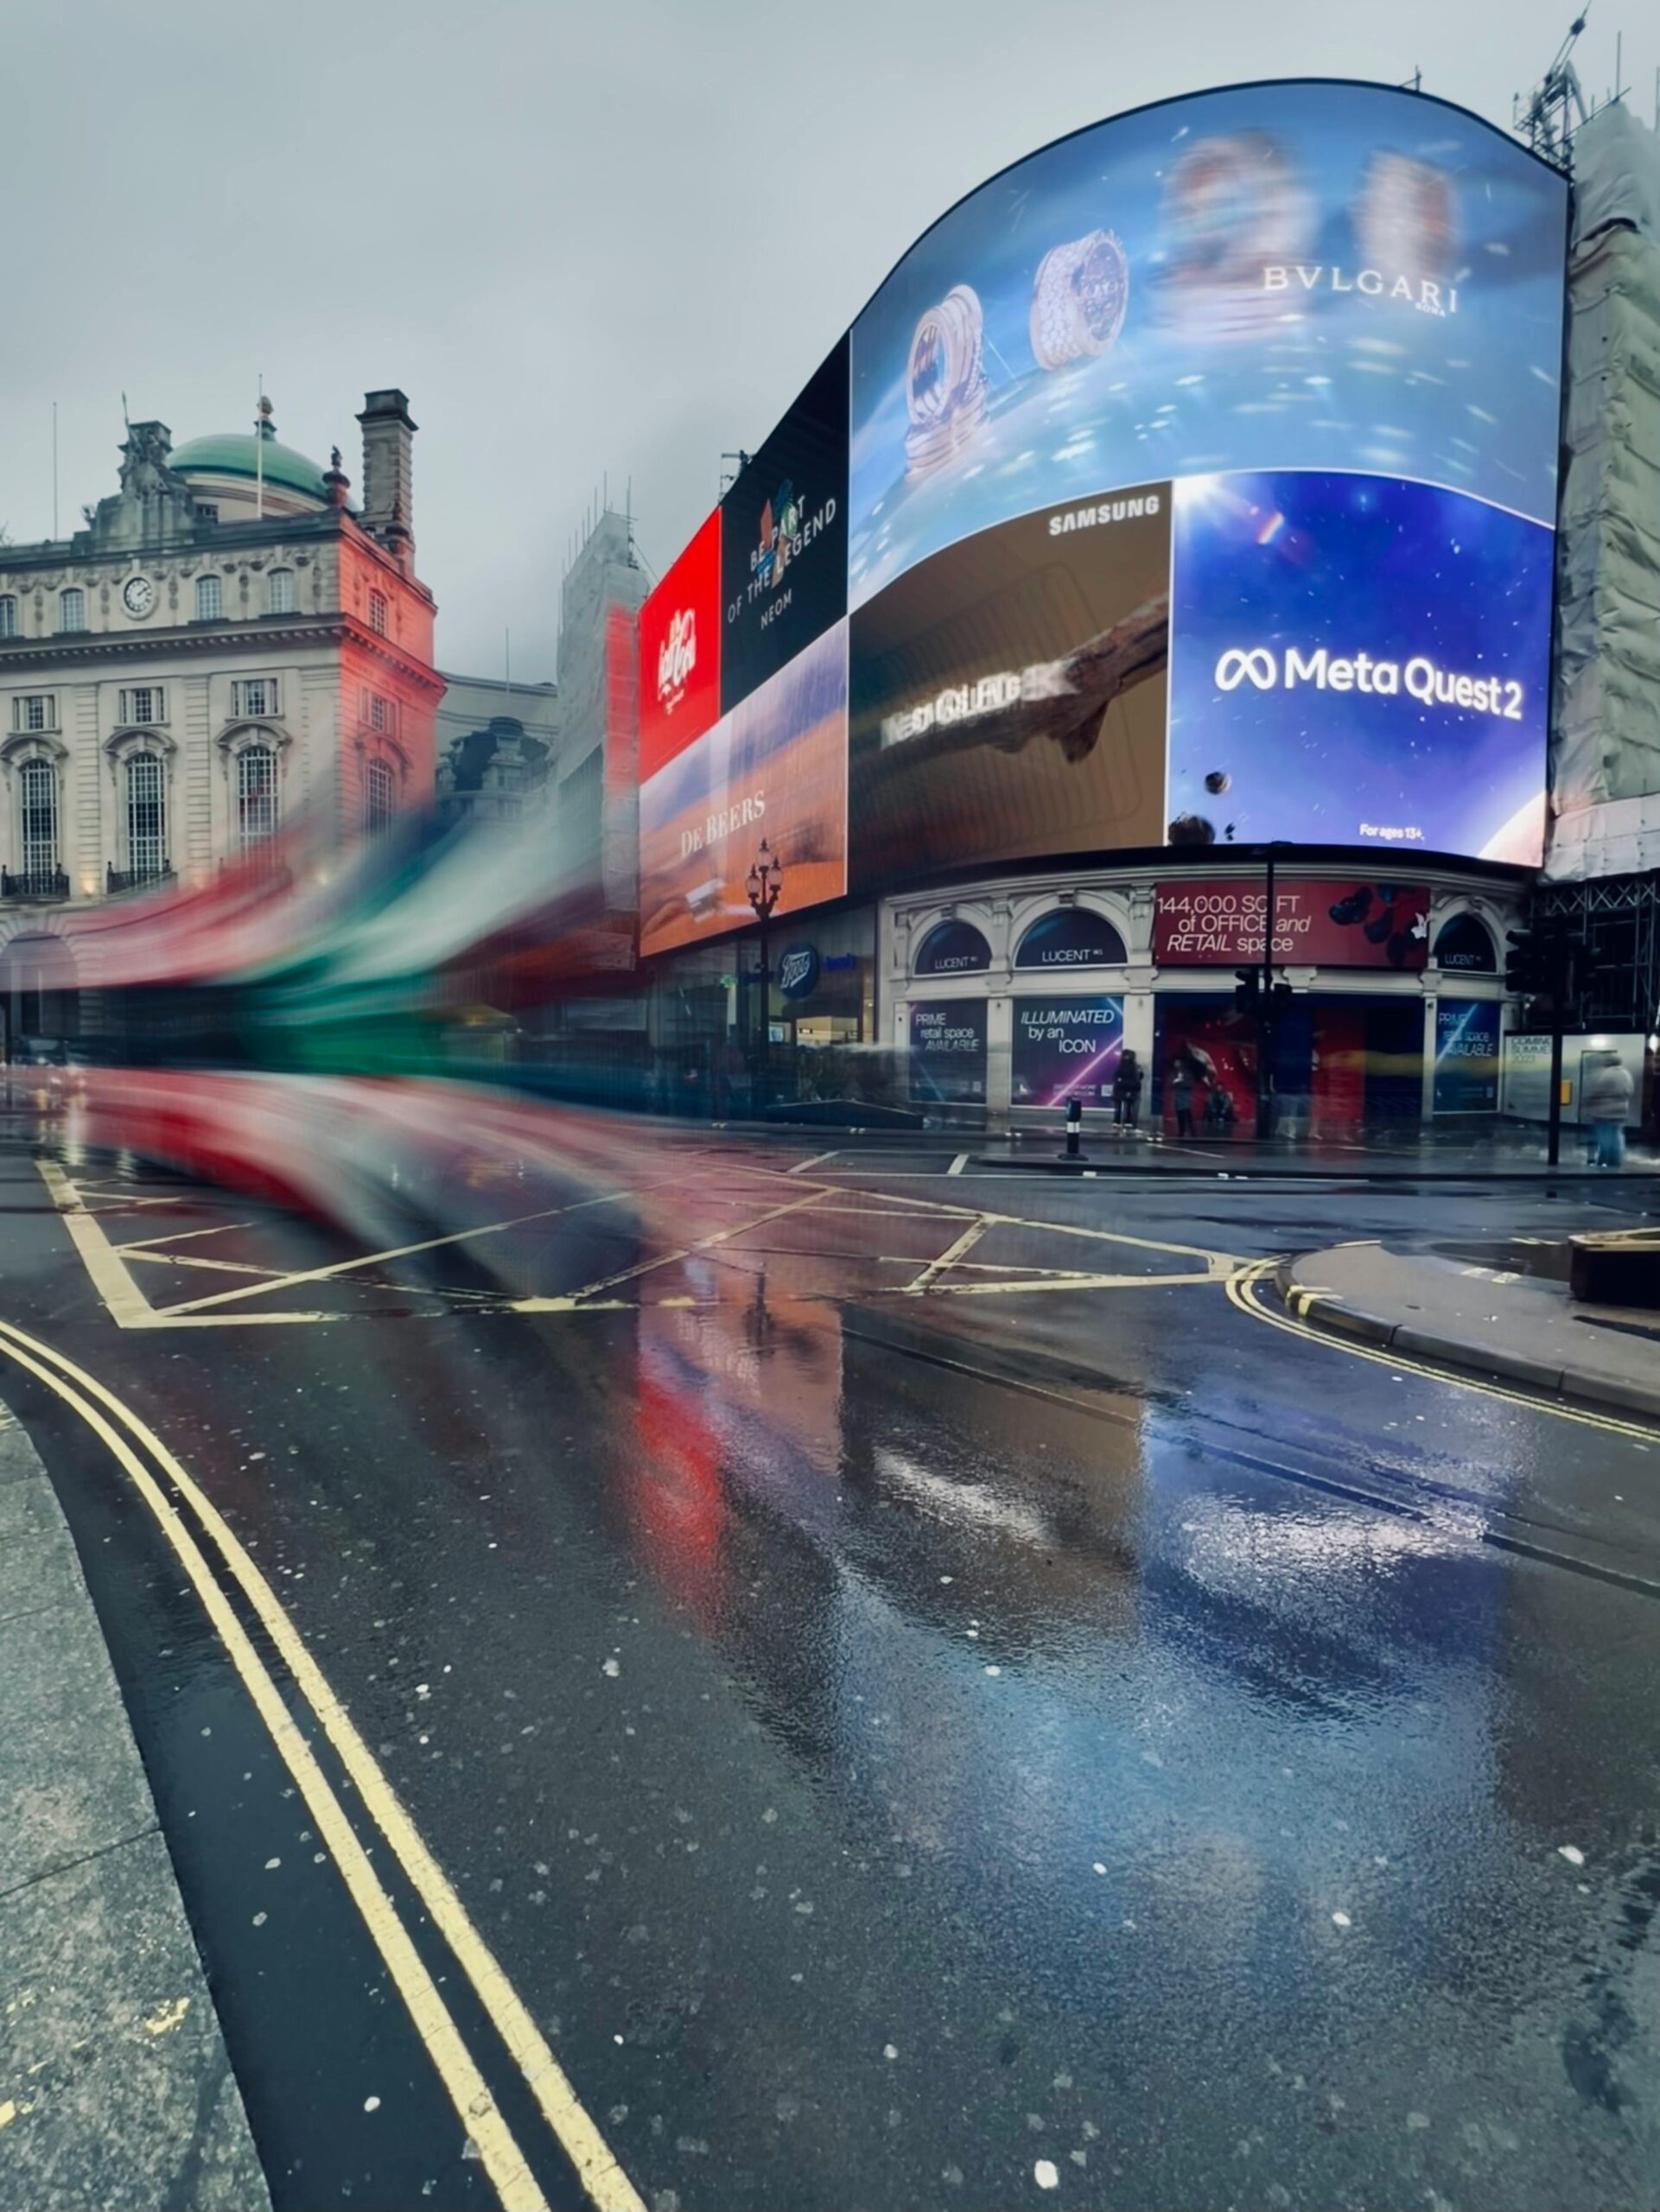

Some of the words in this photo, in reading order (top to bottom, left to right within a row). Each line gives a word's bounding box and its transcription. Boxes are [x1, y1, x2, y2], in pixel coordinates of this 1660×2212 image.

[1263, 266, 1458, 313] BVLGARI
[1415, 302, 1446, 317] ROMA
[1048, 495, 1160, 536] SAMSUNG
[750, 540, 766, 572] BE
[771, 494, 805, 550] PART
[728, 594, 742, 623] OF
[747, 564, 771, 604] THE
[776, 498, 836, 575] LEGEND
[1284, 648, 1398, 695] Meta
[681, 826, 703, 858] DE
[706, 790, 766, 846] BEERS
[1359, 823, 1378, 836] For
[1379, 827, 1404, 841] ages
[1157, 895, 1237, 914] 144,000
[1276, 895, 1300, 913] FT
[1178, 914, 1197, 933] of
[1201, 914, 1268, 932] OFFICE
[1275, 915, 1312, 933] and
[1167, 934, 1232, 951] RETAIL
[934, 957, 969, 969] LUCENT
[1042, 950, 1091, 963] LUCENT
[916, 1013, 947, 1027] PRIME
[1021, 1009, 1115, 1026] ILLUMINATED
[944, 1027, 975, 1041] space
[1028, 1025, 1044, 1040] by
[1046, 1027, 1064, 1039] an
[1059, 1039, 1097, 1053] ICON
